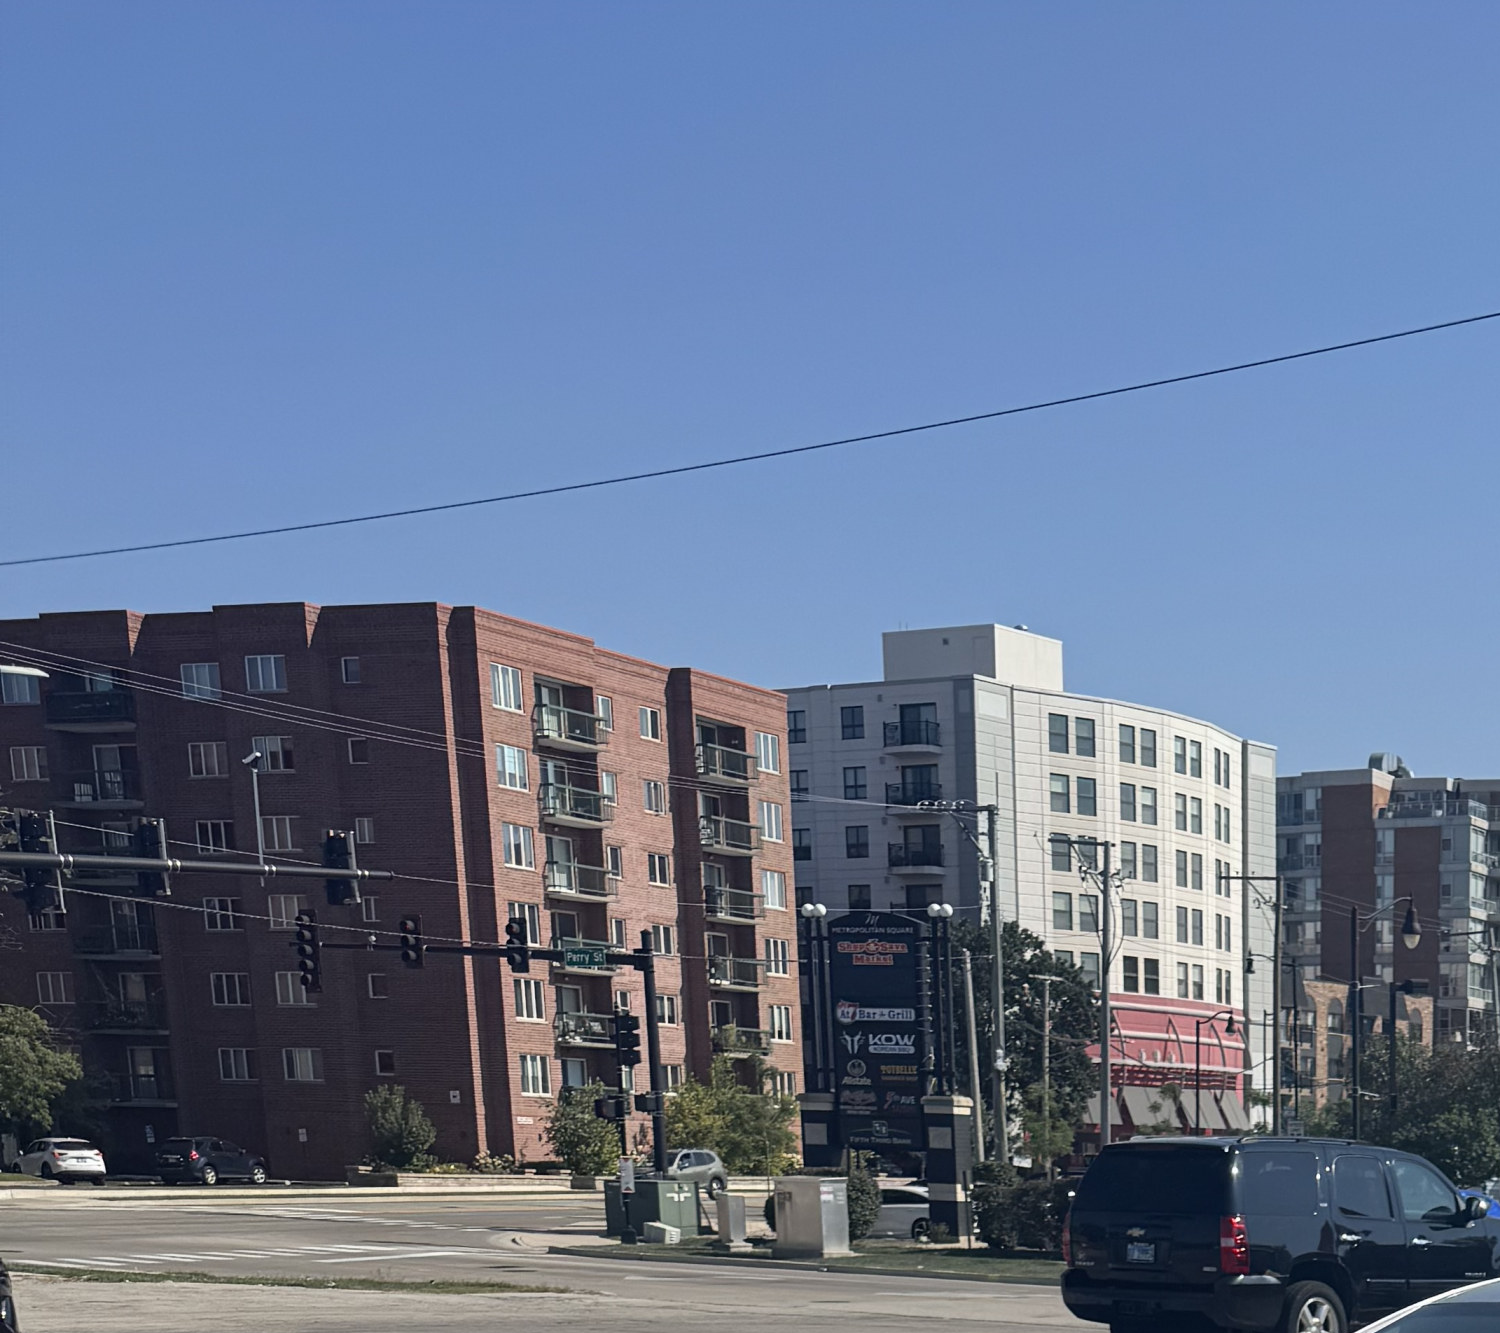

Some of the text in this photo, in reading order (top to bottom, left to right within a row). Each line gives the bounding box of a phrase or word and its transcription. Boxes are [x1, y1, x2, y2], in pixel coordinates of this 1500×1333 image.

[831, 926, 885, 934] METROPOLITAN
[838, 942, 907, 952] Shop Save
[567, 951, 603, 965] Perry St
[853, 954, 893, 965] Market
[840, 1009, 850, 1019] At
[858, 1009, 877, 1020] Bar
[888, 1009, 913, 1020] Grill
[868, 1033, 916, 1046] KOW
